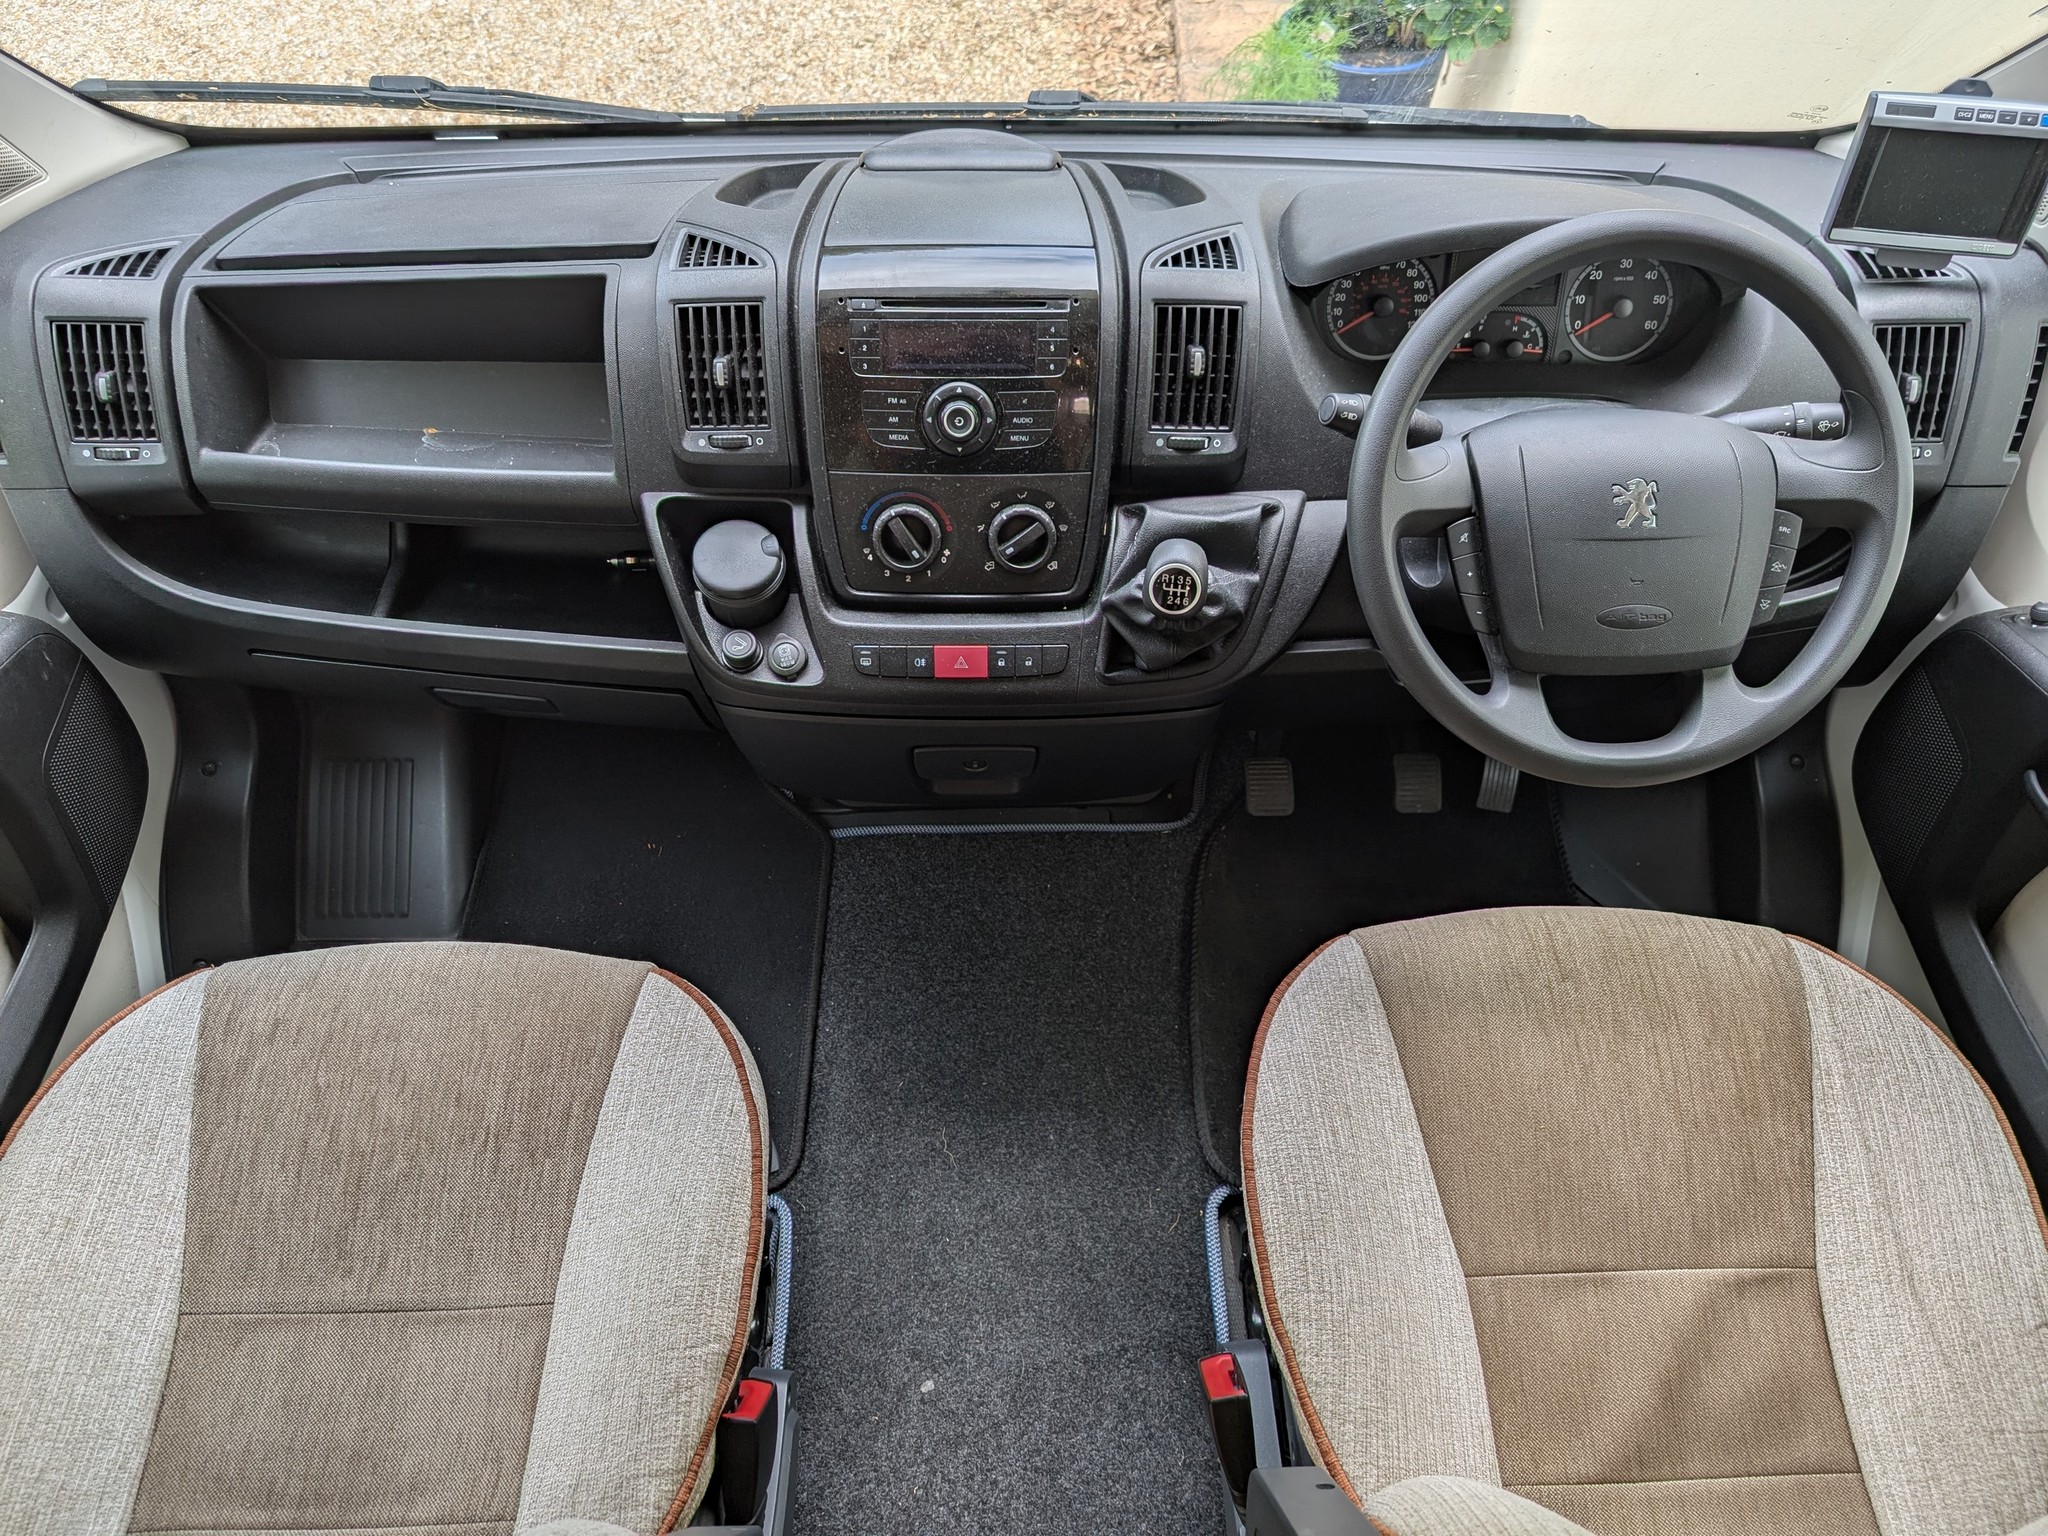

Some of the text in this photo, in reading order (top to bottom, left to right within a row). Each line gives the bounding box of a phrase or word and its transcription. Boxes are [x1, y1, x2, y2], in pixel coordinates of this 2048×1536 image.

[1620, 259, 1633, 268] 30
[1407, 269, 1418, 277] 80
[1590, 271, 1602, 280] 20
[1645, 271, 1658, 280] 40
[1341, 280, 1352, 288] 30
[1413, 281, 1425, 289] 90
[1414, 294, 1428, 302] 100
[1575, 295, 1585, 304] 10
[1653, 295, 1666, 304] 50
[1333, 307, 1342, 315] 10
[1575, 321, 1581, 329] 0
[1644, 321, 1658, 330] 60
[1778, 526, 1791, 534] SRC
[1162, 574, 1191, 585] R 1 3 5
[1167, 596, 1189, 606] 2 4 6
